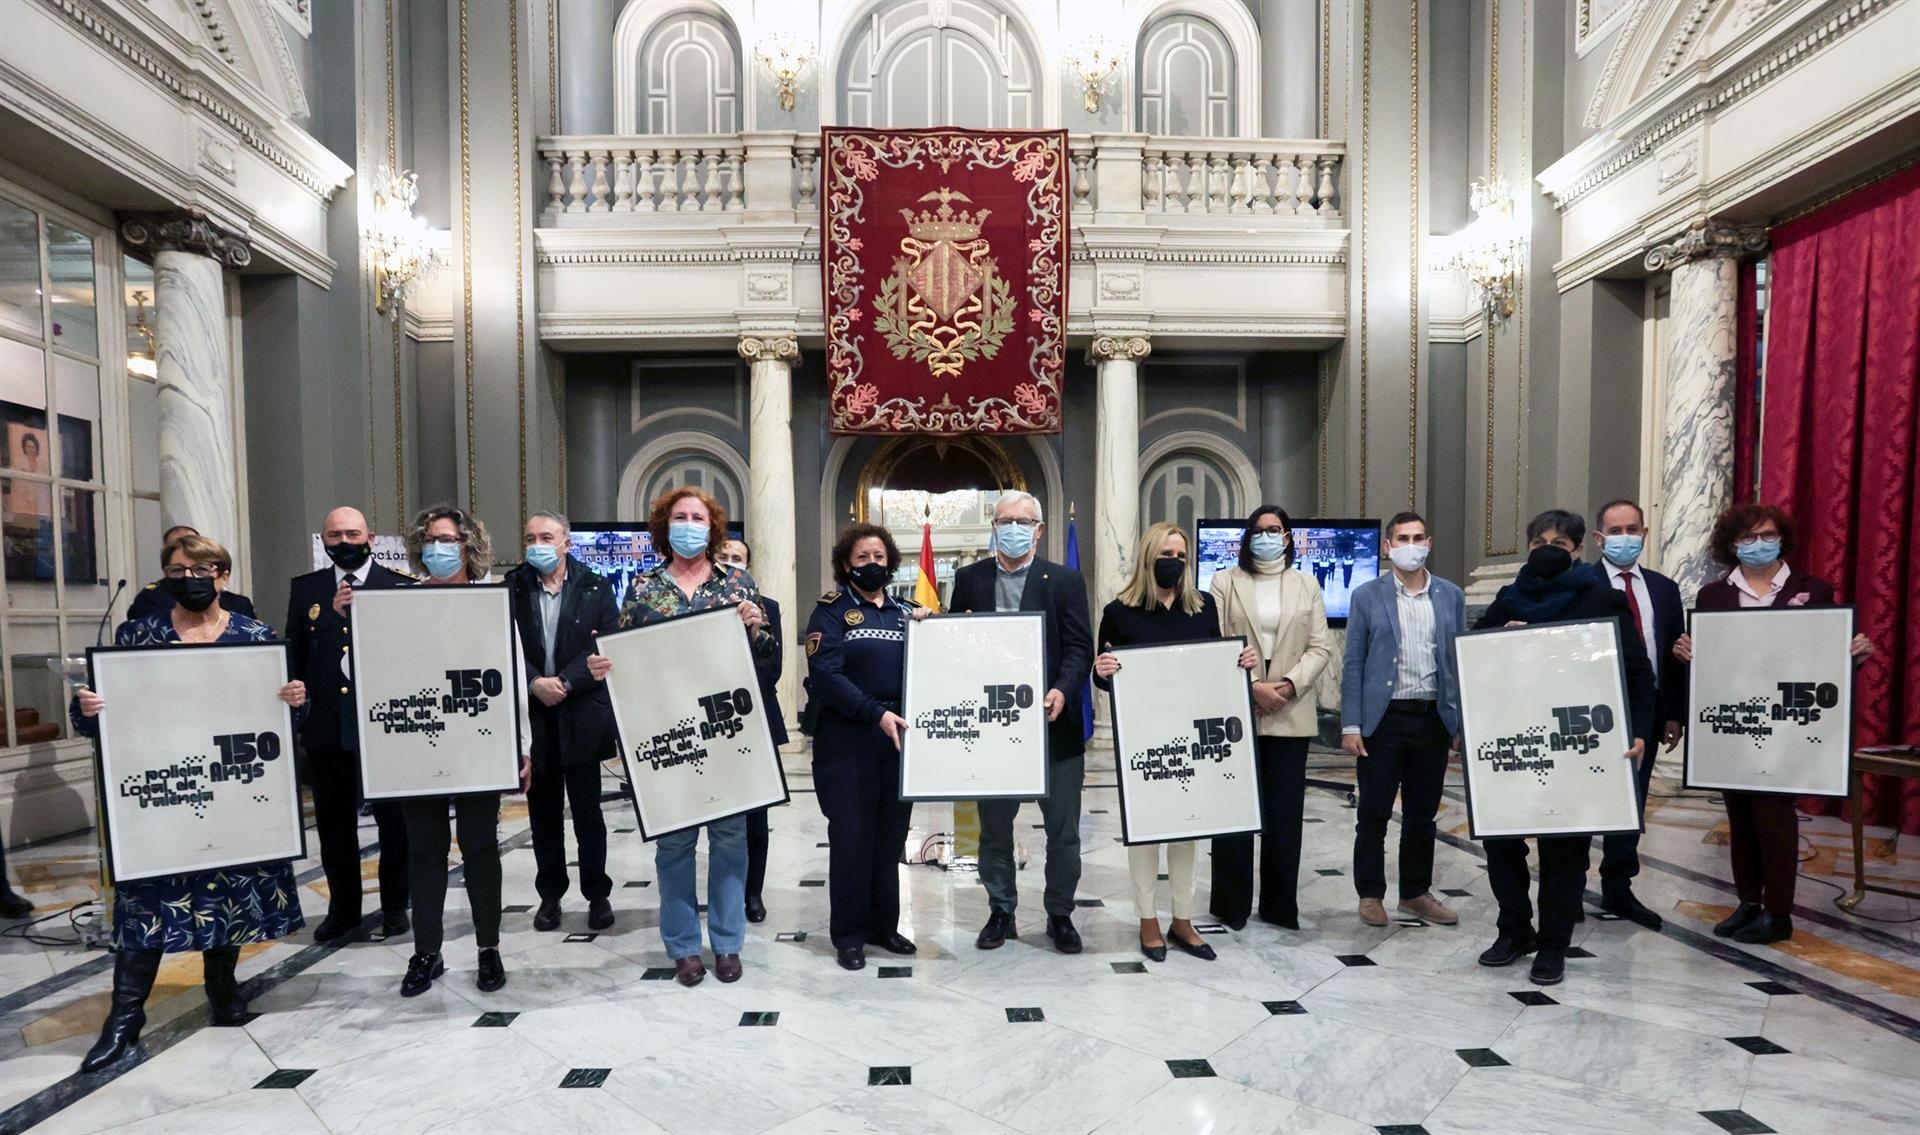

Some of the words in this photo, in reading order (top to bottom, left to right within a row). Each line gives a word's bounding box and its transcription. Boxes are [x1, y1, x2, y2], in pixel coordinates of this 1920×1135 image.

[445, 668, 503, 698] 150
[1777, 682, 1839, 709] 150
[441, 694, 489, 717] Anys
[697, 687, 754, 724] 150
[983, 684, 1034, 710] 150
[978, 706, 1020, 727] Anys
[1552, 704, 1614, 736] 150
[1771, 703, 1821, 726] Anys
[699, 717, 744, 741] Anys
[1193, 716, 1243, 746] 150
[213, 731, 281, 766] 150
[1191, 742, 1232, 763] Anys
[1549, 731, 1600, 754] Anys
[210, 761, 265, 785] Anys
